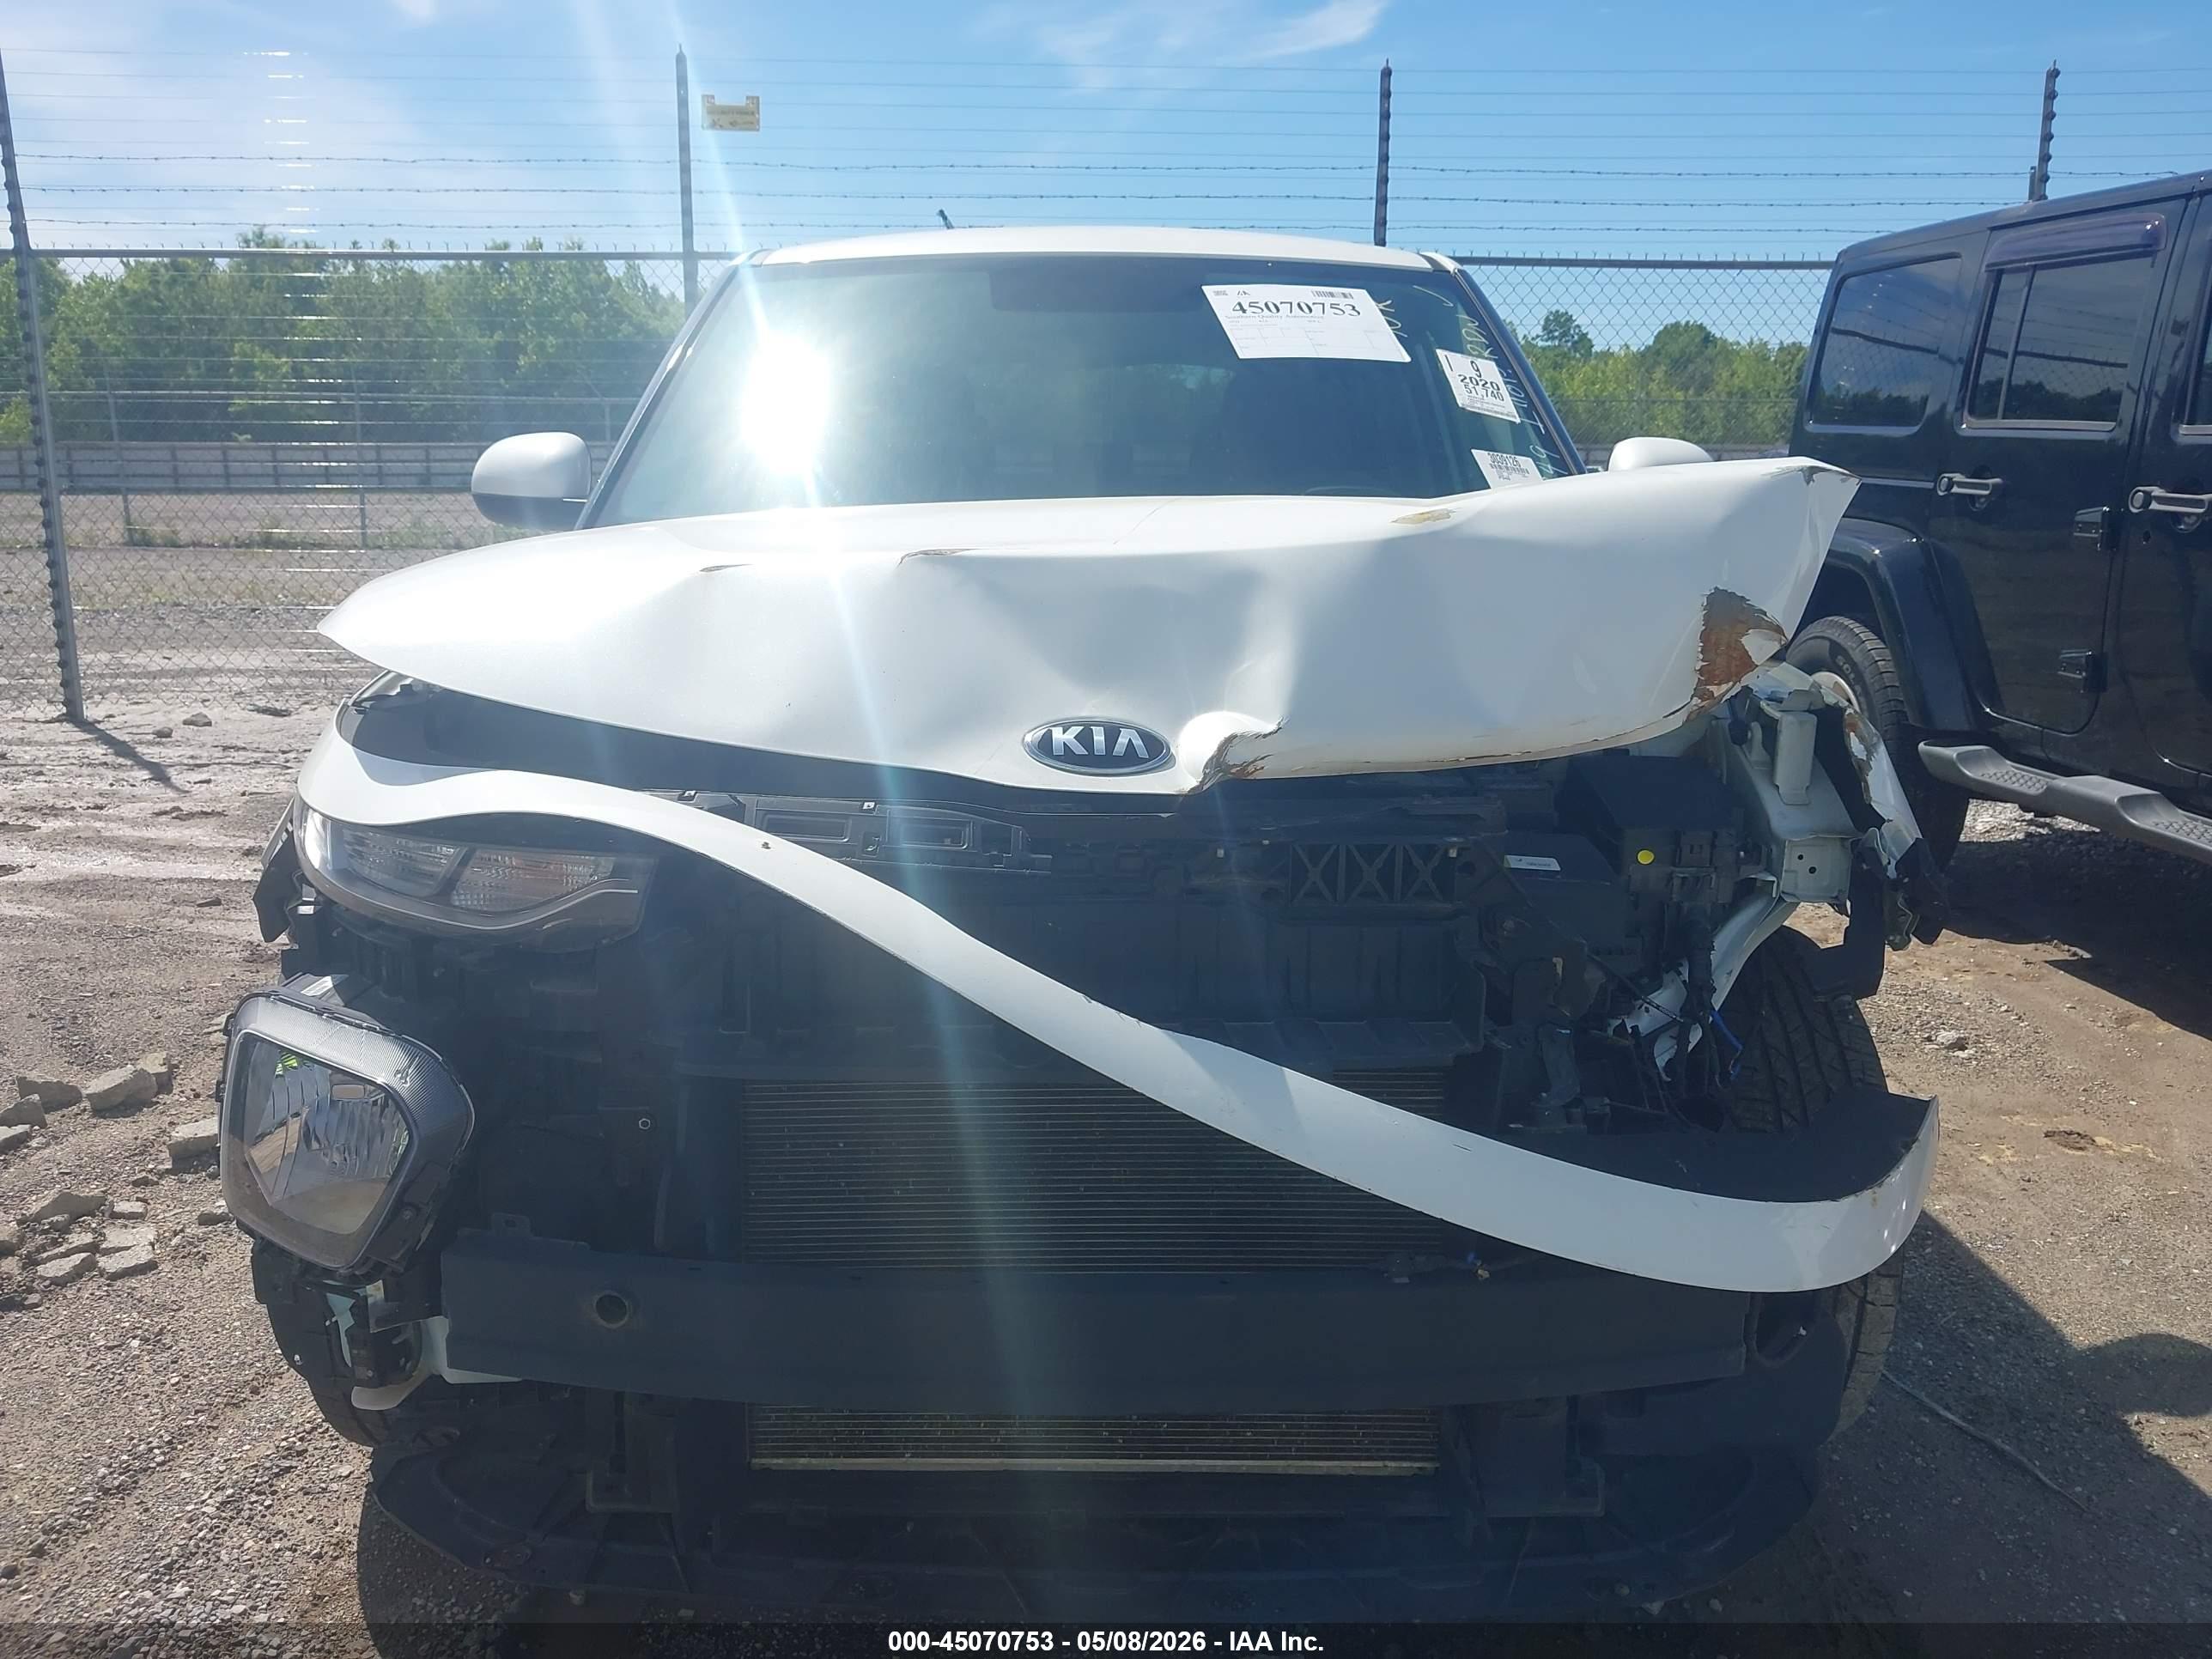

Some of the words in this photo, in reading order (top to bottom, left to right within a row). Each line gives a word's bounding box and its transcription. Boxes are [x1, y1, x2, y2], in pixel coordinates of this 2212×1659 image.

[1231, 301, 1361, 317] 45070753
[1470, 361, 1482, 378] 9
[1459, 374, 1501, 391] 2020
[1463, 384, 1504, 402] 51,740
[1048, 726, 1149, 758] KIA
